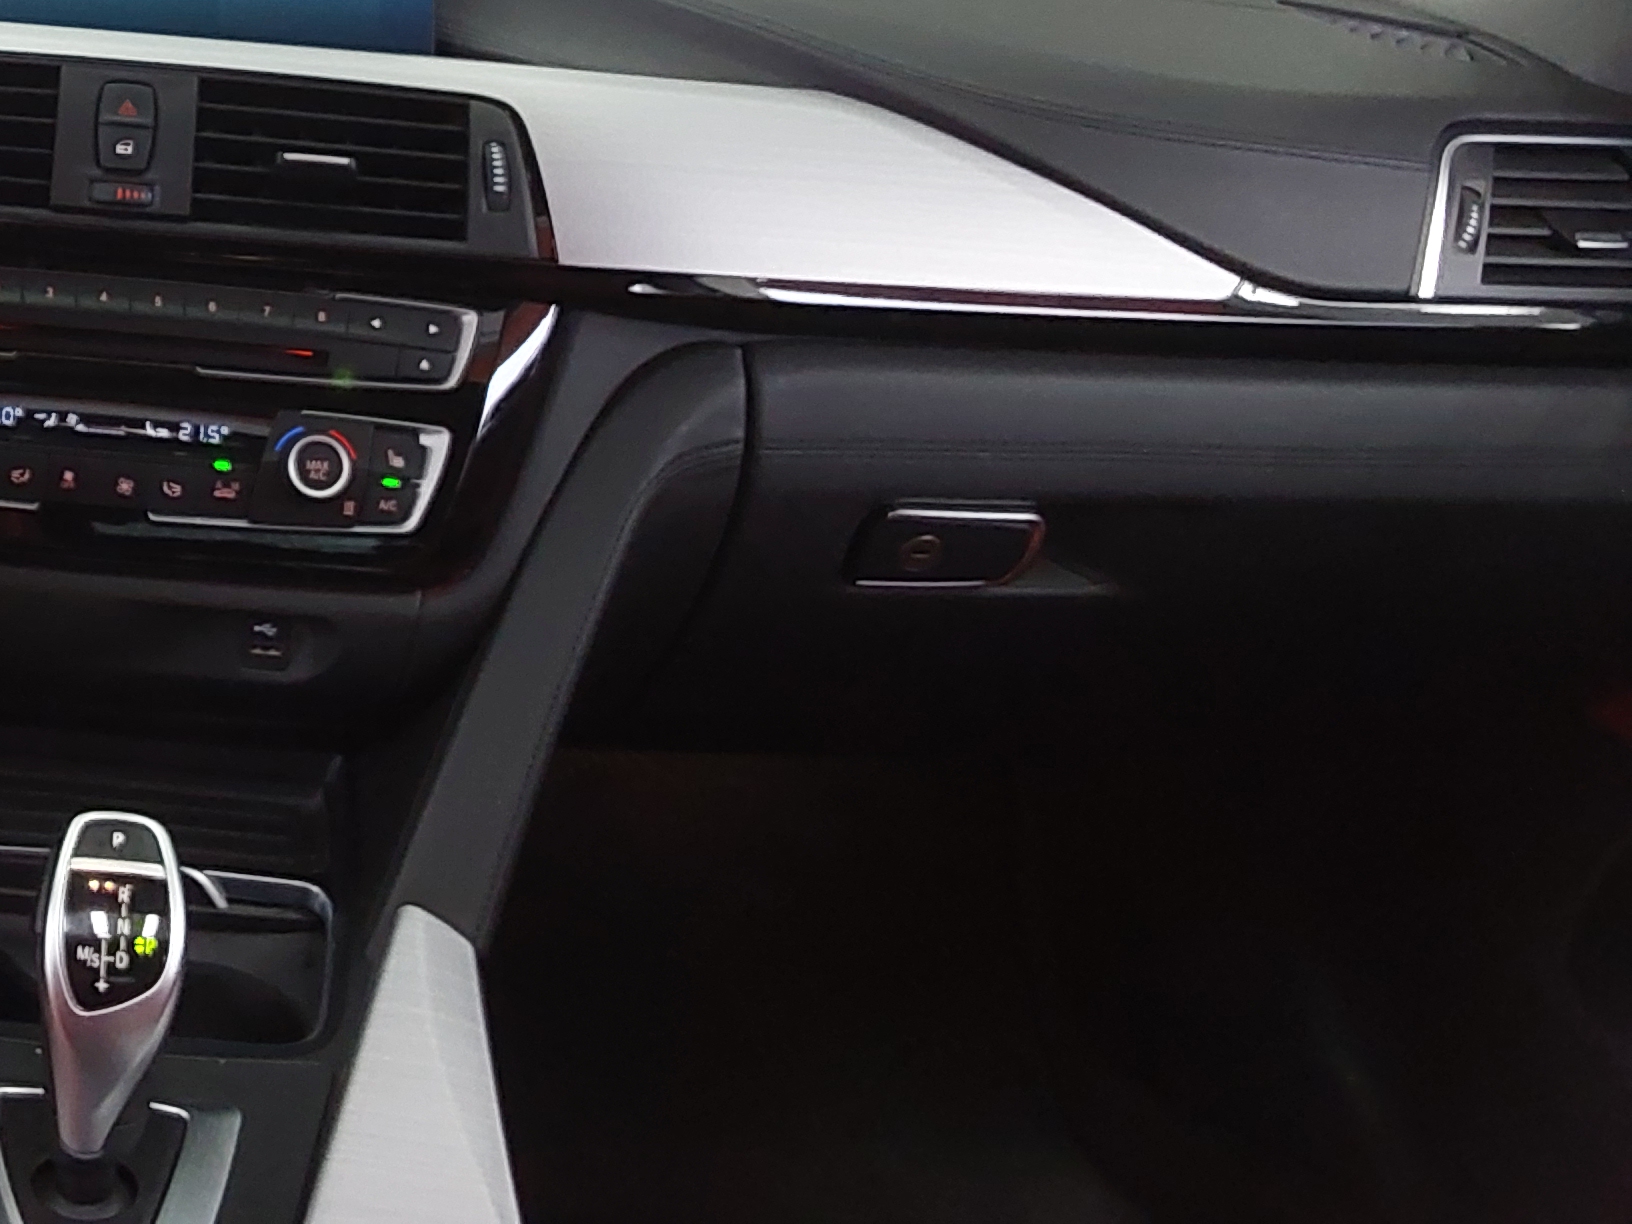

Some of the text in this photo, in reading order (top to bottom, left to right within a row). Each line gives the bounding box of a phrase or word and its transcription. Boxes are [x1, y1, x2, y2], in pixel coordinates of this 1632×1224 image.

[46, 287, 54, 298] 3
[99, 291, 108, 302] 4
[154, 296, 162, 307] 5
[263, 305, 272, 317] 7
[379, 499, 397, 511] A/C
[112, 832, 126, 848] P
[115, 951, 130, 969] D
